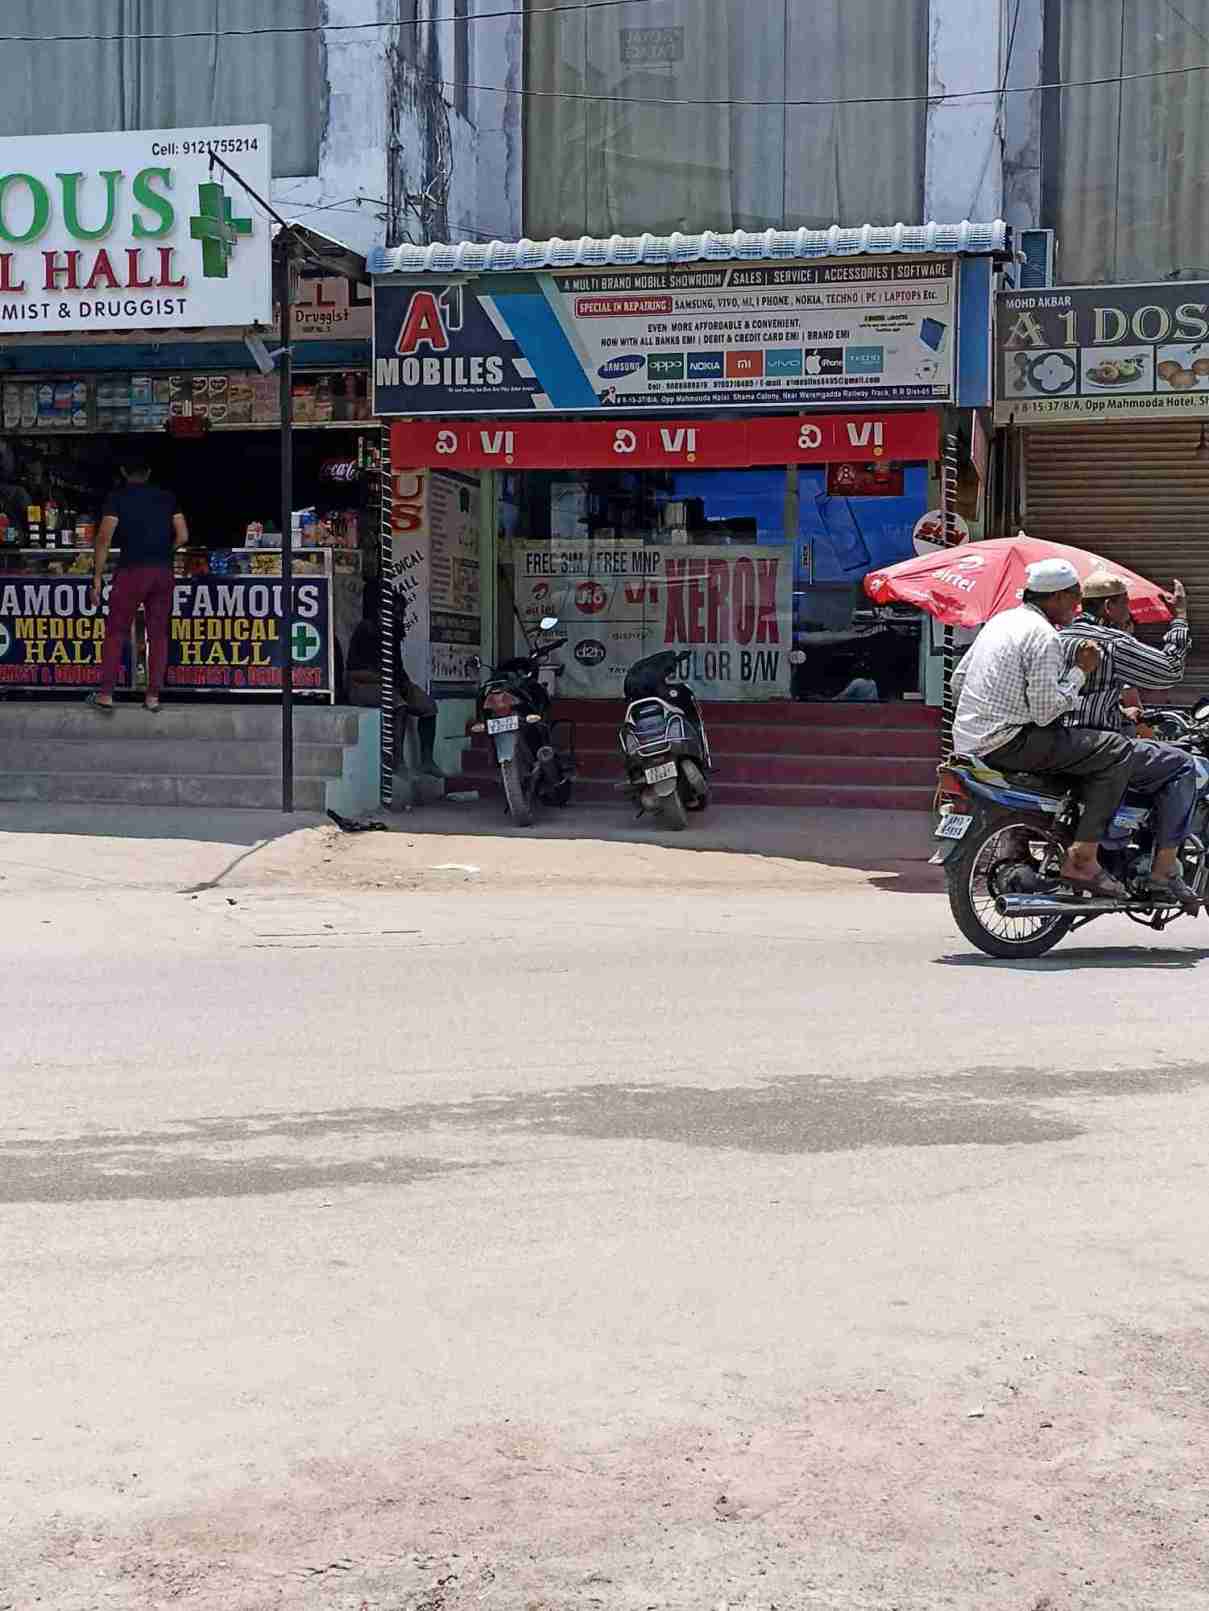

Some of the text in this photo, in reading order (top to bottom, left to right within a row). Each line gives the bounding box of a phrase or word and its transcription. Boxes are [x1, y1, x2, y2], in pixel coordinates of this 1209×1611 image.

[152, 138, 258, 156] Cell: 9121755214
[0, 167, 174, 242] OUS
[41, 247, 186, 290] HALL
[573, 278, 599, 290] MULTI
[601, 277, 632, 289] BRAND
[634, 275, 667, 288] MOBILE
[669, 272, 722, 288] SHOWROOM
[732, 271, 762, 285] SALES
[773, 269, 812, 283] SERVICE
[824, 266, 889, 282] ACCESSORIES
[896, 263, 947, 278] SOFTWARE
[2, 299, 187, 320] MIST & DRUGGIST
[579, 302, 610, 314] SPECIAL
[612, 302, 623, 313] IN
[826, 293, 859, 305] TECHNO
[1006, 296, 1072, 309] MOHD AKBAR
[295, 308, 349, 325] Druggist
[648, 323, 668, 333] EVEN
[671, 321, 692, 332] MORE
[694, 319, 743, 332] AFFORDABLE
[1093, 303, 1209, 345] DOS
[600, 336, 619, 347] NOW
[620, 335, 639, 346] WITH
[640, 334, 654, 346] ALL
[655, 333, 680, 346] BANKS
[703, 333, 726, 345] DEBIT
[734, 332, 761, 344] CREDIT
[763, 331, 784, 343] CARD
[807, 329, 834, 341] BRAND
[376, 356, 503, 386] MOBILES
[689, 361, 721, 371] NOKIA
[1085, 399, 1105, 413] Opp
[1107, 396, 1164, 410] Mahmooda
[526, 552, 556, 574] FREE
[560, 552, 584, 574] SIM
[596, 551, 628, 573] FREE
[632, 551, 661, 573] MNP
[930, 568, 977, 592] airtel
[664, 557, 781, 645] XEROX
[16, 618, 105, 640] MEDICA
[171, 619, 280, 641] MEDICAL
[180, 641, 271, 666] HALL
[741, 650, 779, 684] B/W
